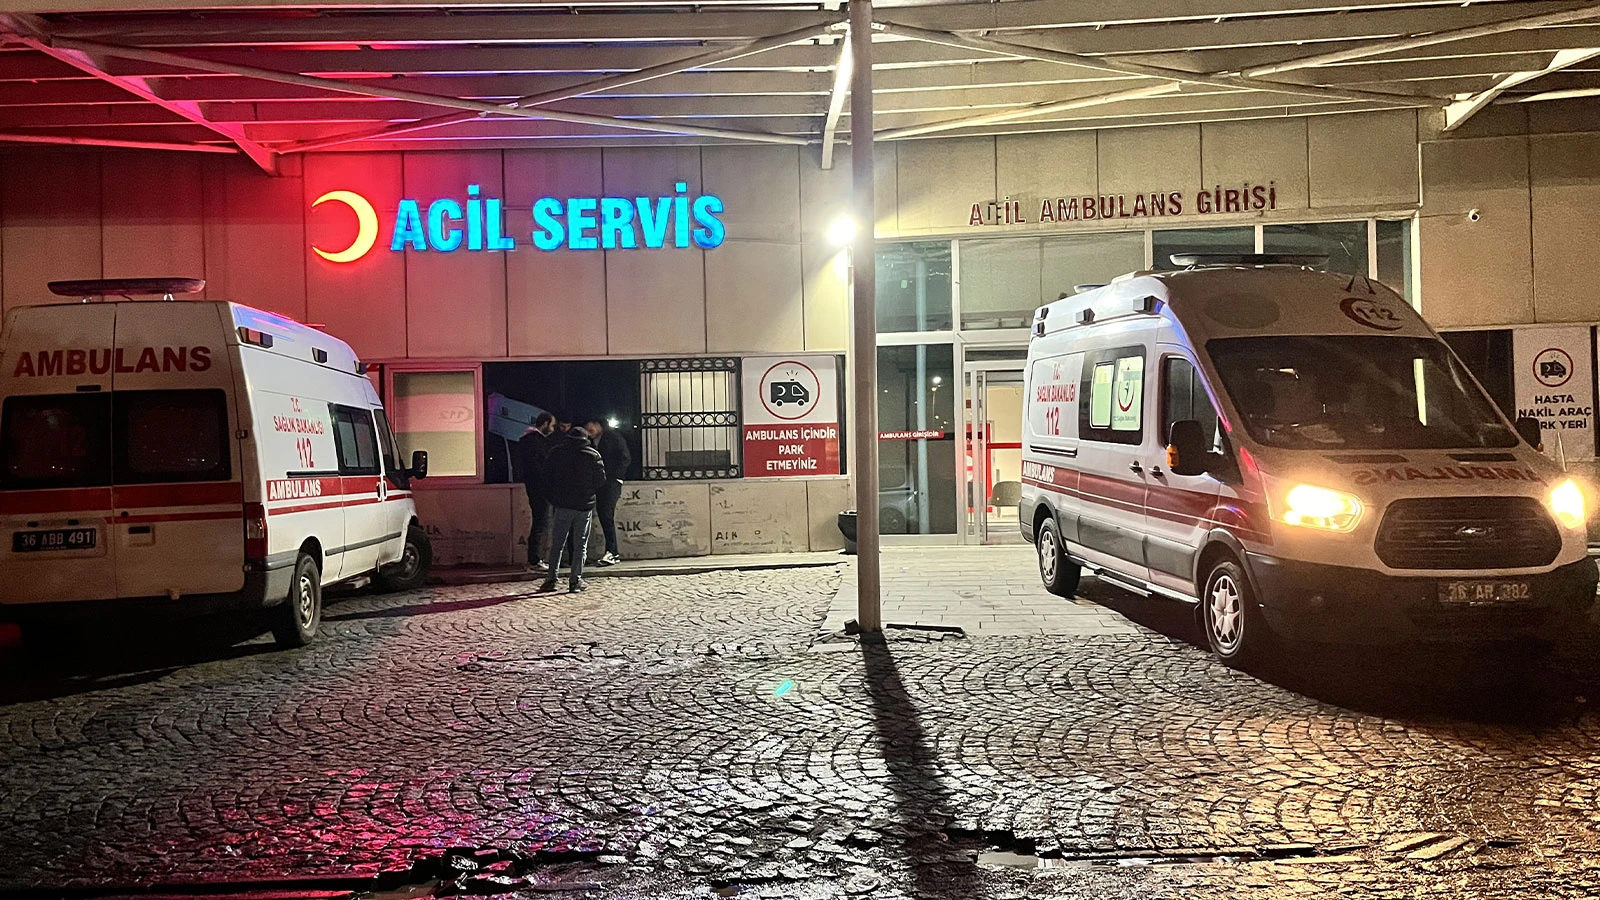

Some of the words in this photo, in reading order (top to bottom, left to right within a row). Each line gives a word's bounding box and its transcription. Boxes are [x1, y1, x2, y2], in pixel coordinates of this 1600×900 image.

[1040, 192, 1183, 222] AMBULANS
[390, 184, 515, 252] ACİL
[532, 182, 726, 250] SERVİS
[1356, 307, 1402, 320] 112
[14, 347, 212, 377] AMBULANS
[1535, 394, 1575, 404] HASTA
[1519, 406, 1555, 417] NAKİL
[1559, 407, 1592, 417] ARAÇ
[1046, 407, 1060, 435] 112
[1541, 421, 1556, 430] RK
[1560, 418, 1587, 429] YERİ
[746, 430, 798, 441] AMBULANS
[801, 426, 836, 440] İÇİNDİR
[297, 438, 315, 468] 112
[779, 445, 804, 454] PARK
[766, 457, 817, 470] ETMEYİNİZ
[1023, 461, 1055, 483] AMBULANS
[270, 480, 321, 499] AMBULANS
[21, 534, 36, 546] 36
[68, 531, 91, 544] 491
